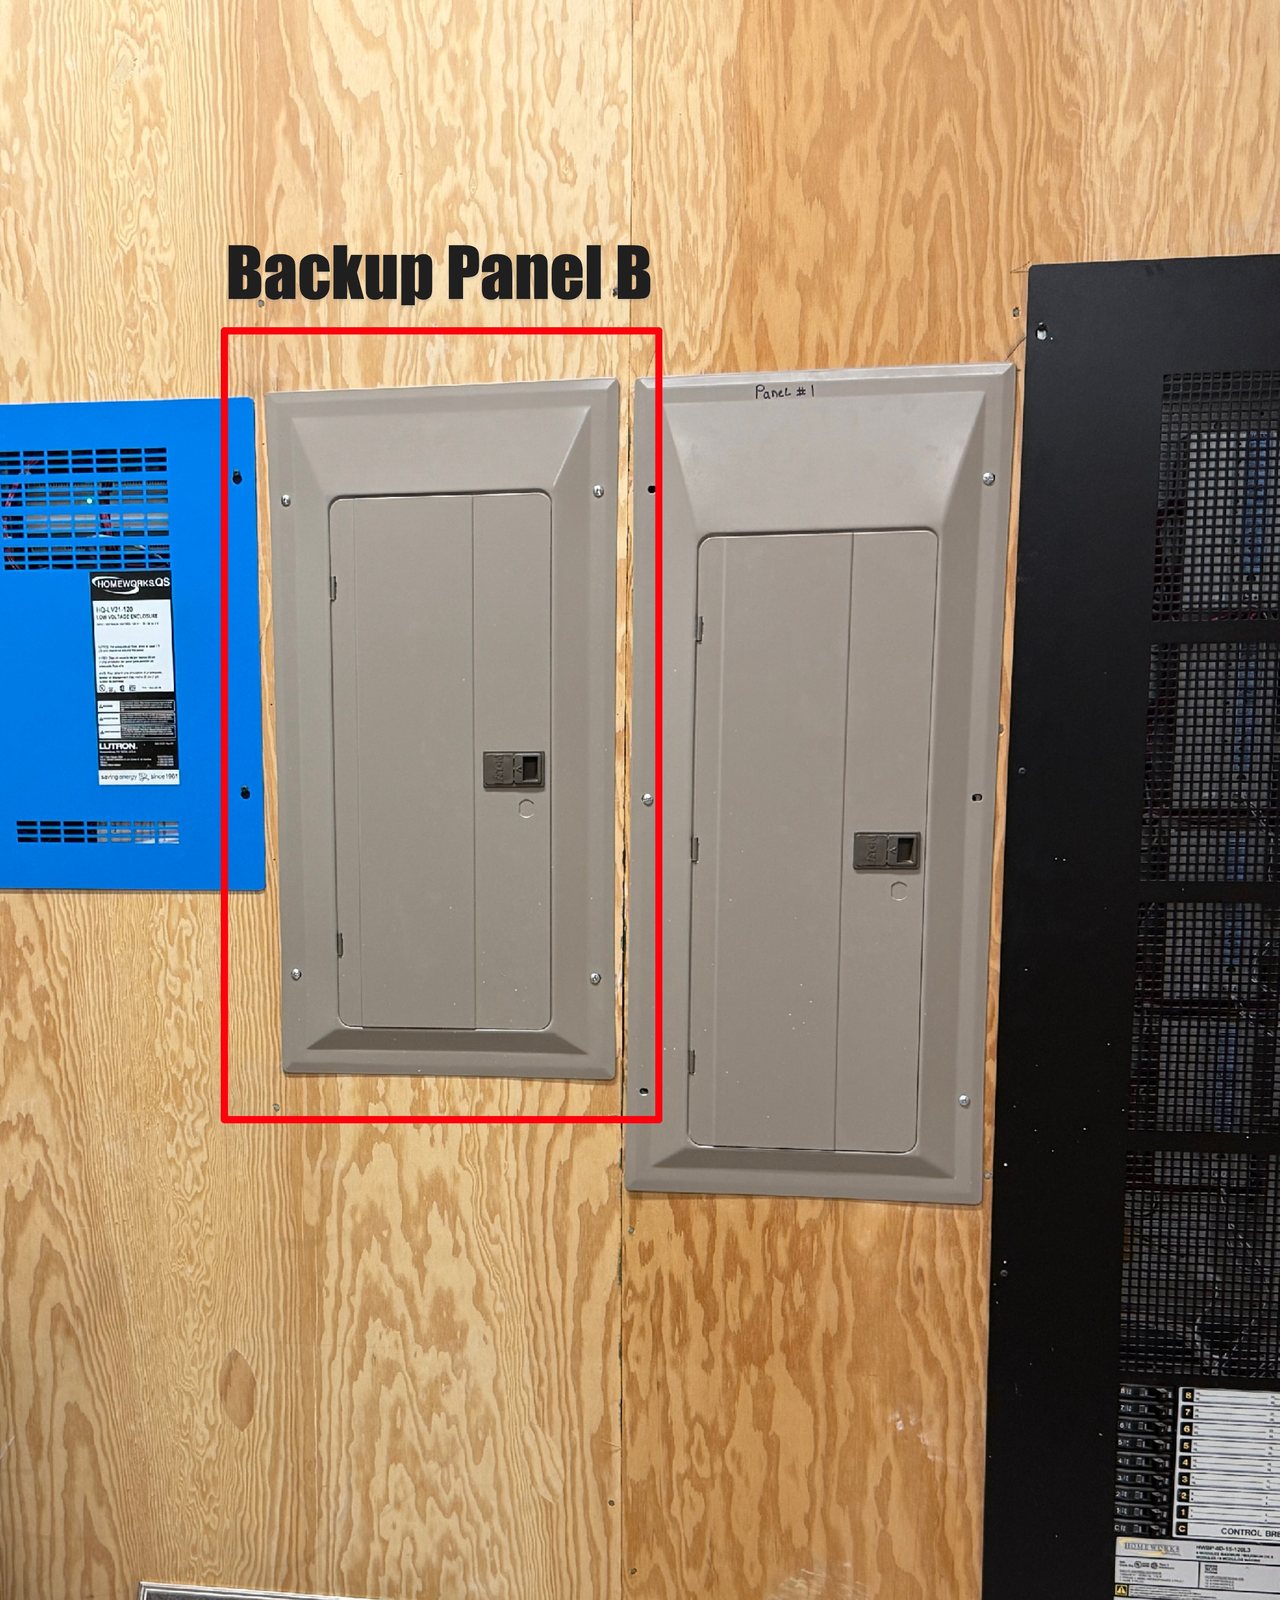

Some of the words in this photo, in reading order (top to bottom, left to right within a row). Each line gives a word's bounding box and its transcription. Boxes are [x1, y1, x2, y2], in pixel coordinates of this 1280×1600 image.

[154, 576, 171, 587] QS
[98, 742, 136, 750] LUTRON
[100, 773, 119, 782] saving
[119, 773, 138, 782] energy
[150, 772, 166, 781] since
[1185, 1391, 1192, 1399] 8
[1184, 1408, 1191, 1416] 7
[1183, 1425, 1191, 1433] 6
[1183, 1442, 1190, 1450] 5
[1181, 1475, 1188, 1483] 3
[1181, 1508, 1186, 1516] 1
[1221, 1527, 1263, 1537] CONTROL
